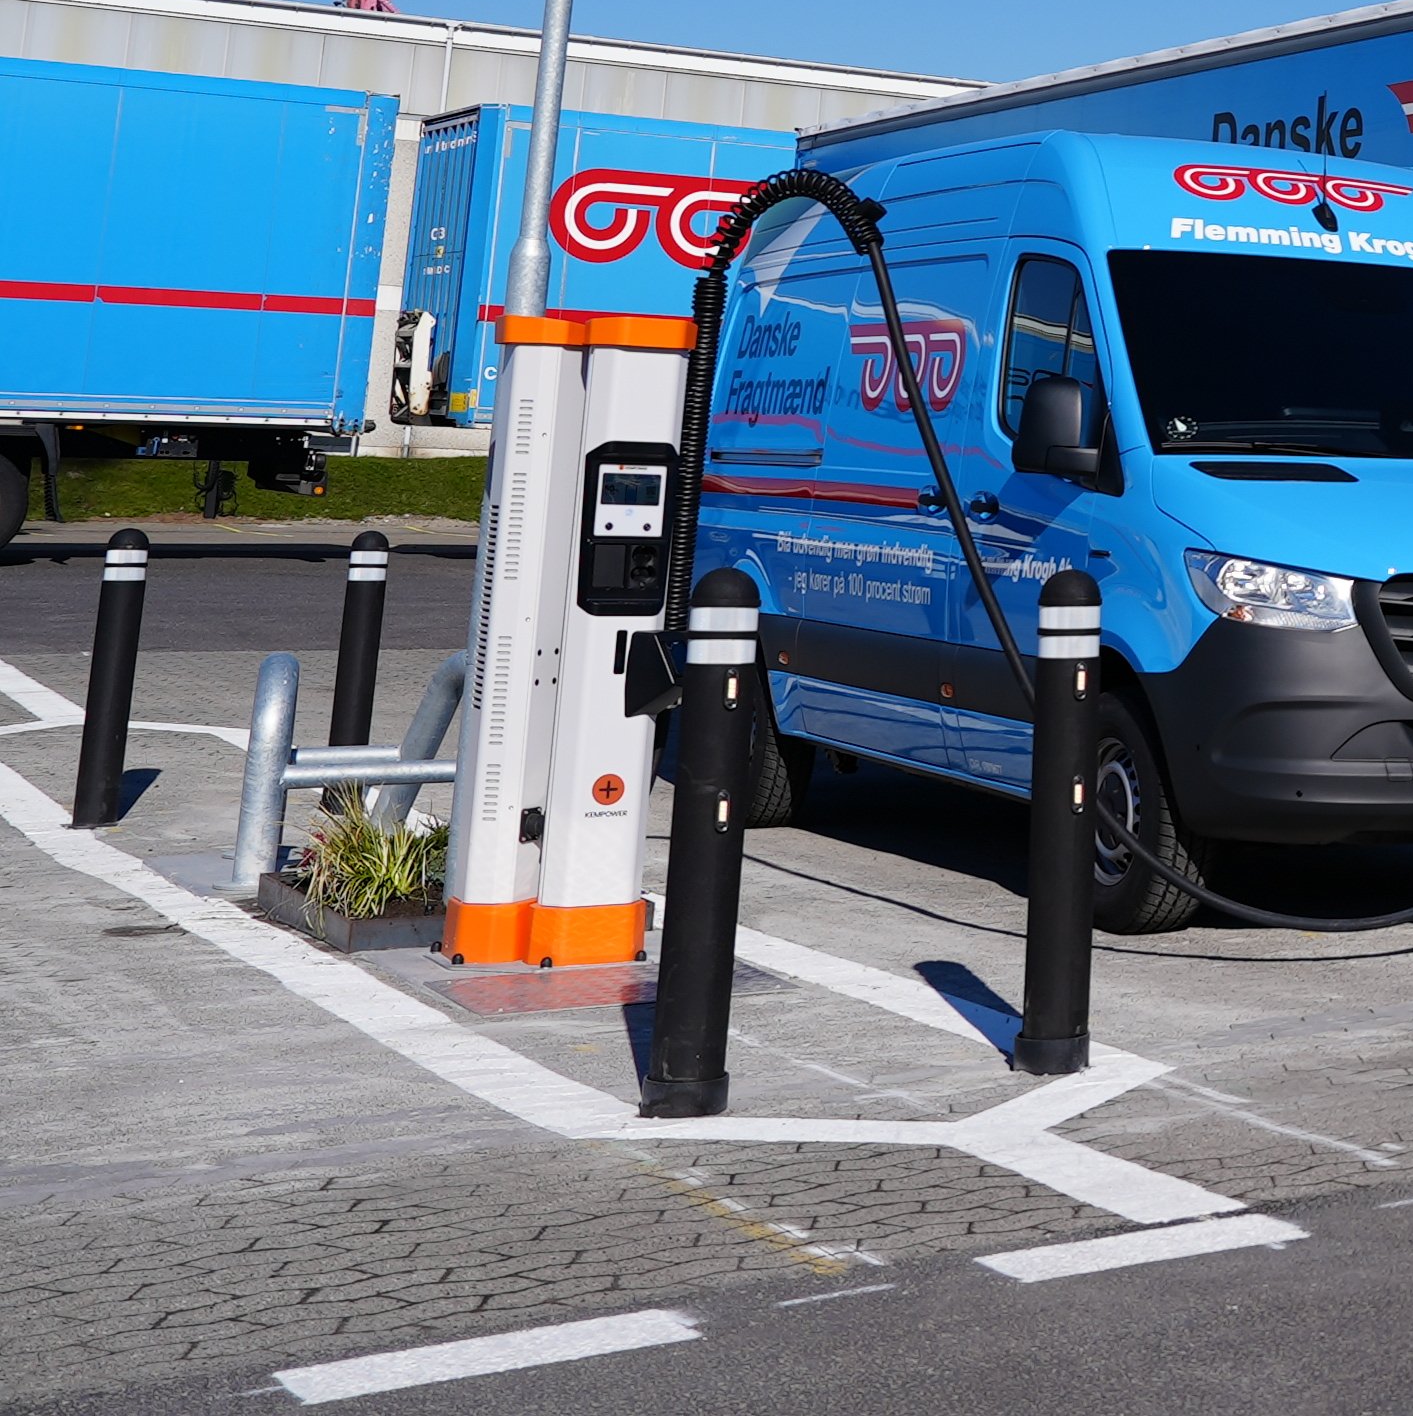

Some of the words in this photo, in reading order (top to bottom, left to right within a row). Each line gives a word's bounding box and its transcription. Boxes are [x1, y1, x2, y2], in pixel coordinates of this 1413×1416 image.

[430, 227, 446, 241] C3
[1170, 217, 1342, 255] Flemming
[737, 311, 802, 360] Danske
[725, 366, 831, 428] Fragtmænd
[881, 540, 933, 575] indvendig
[1022, 554, 1057, 586] Krogh
[793, 566, 807, 595] jeg
[809, 568, 831, 592] kører
[833, 571, 845, 599] på
[848, 573, 864, 596] 100
[865, 579, 901, 603] procent
[902, 583, 931, 605] strøm
